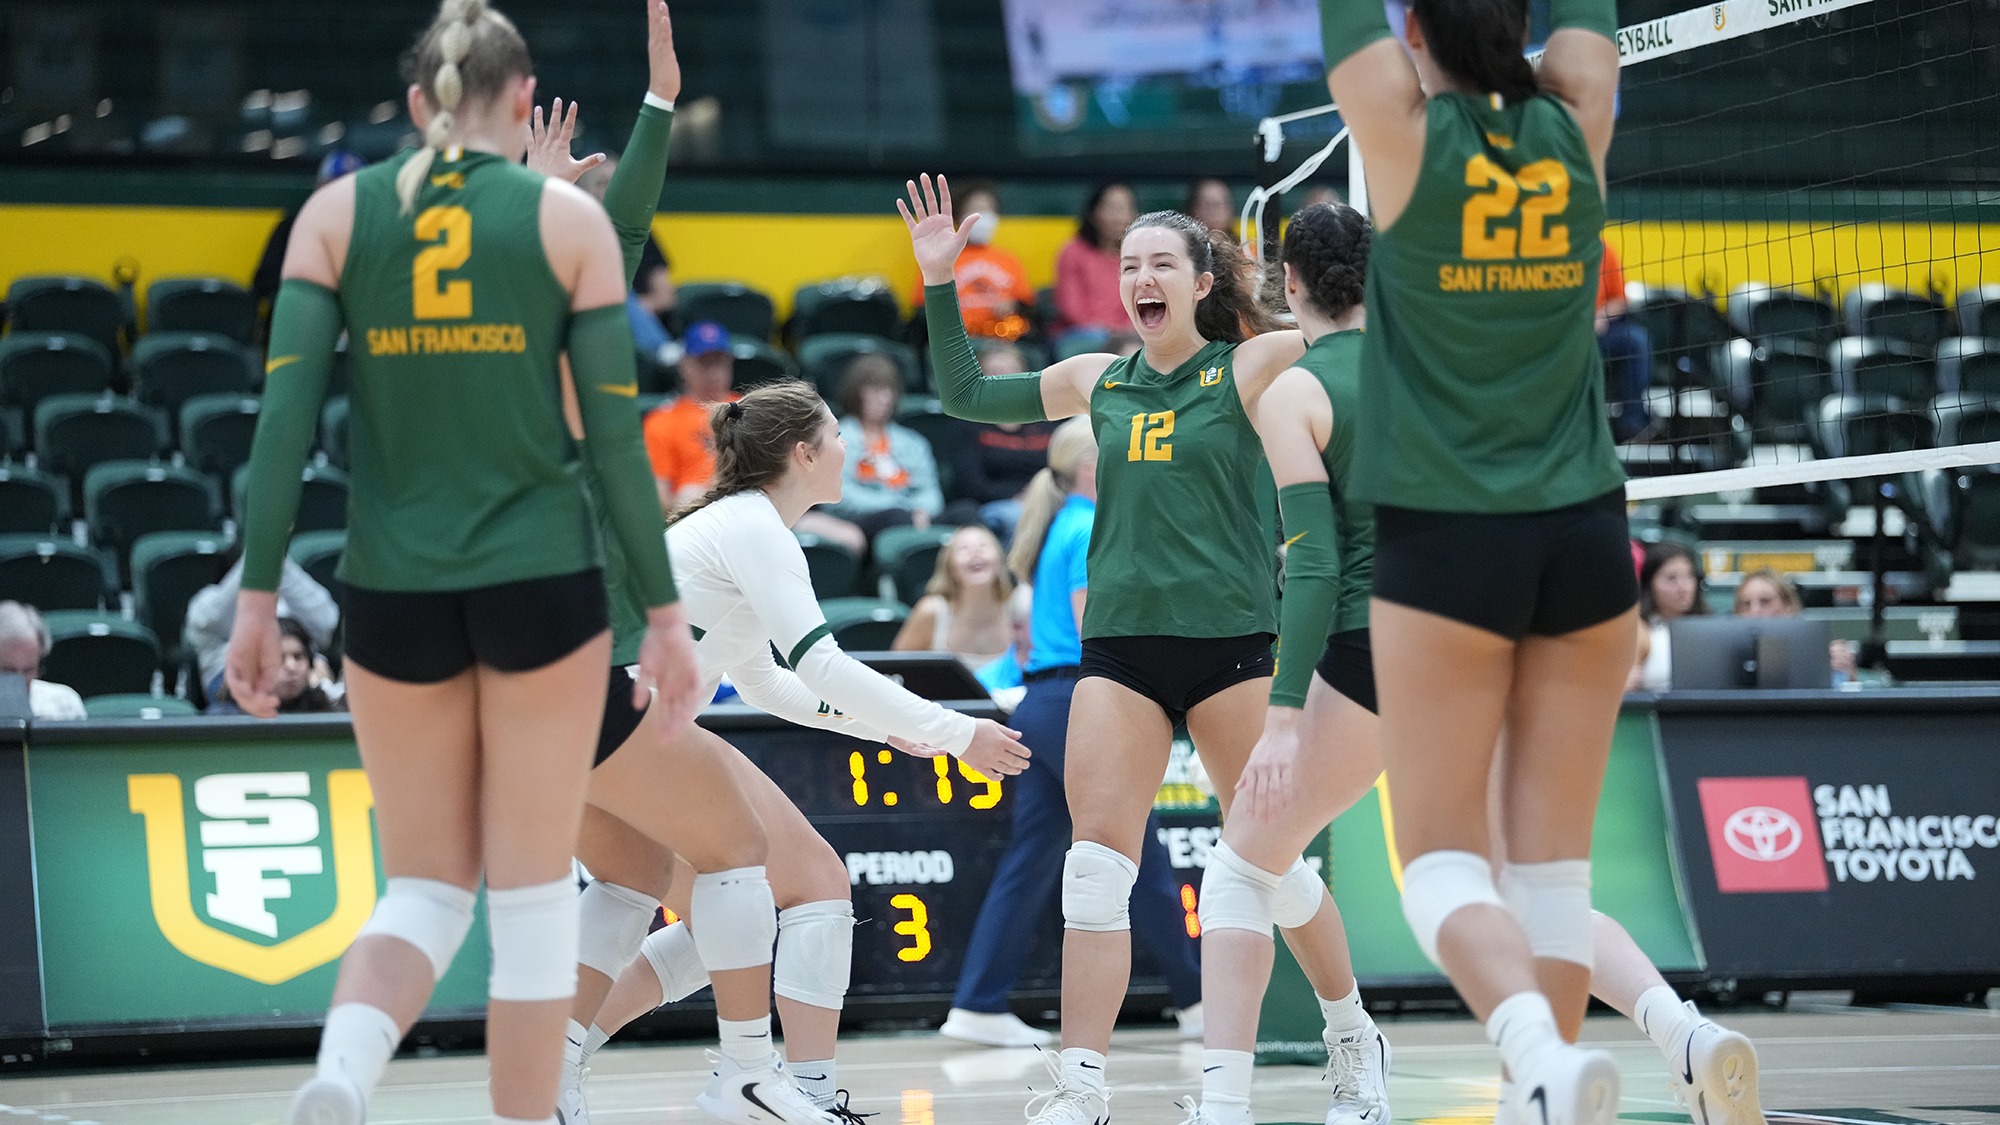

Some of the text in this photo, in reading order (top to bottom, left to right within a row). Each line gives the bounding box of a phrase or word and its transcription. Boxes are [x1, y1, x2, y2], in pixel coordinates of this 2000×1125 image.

[1617, 20, 1673, 57] EYBALL
[1462, 153, 1571, 260] 22
[413, 205, 472, 320] 2
[1439, 262, 1584, 292] SAN FRANCISCO
[366, 324, 526, 356] SAN FRANCISCO
[1127, 410, 1176, 462] 12
[1813, 784, 1892, 817] SAN
[1821, 814, 2000, 849] FRANCISC
[846, 850, 954, 885] PERIOD
[1825, 848, 1977, 882] TOYOTA
[890, 894, 931, 961] 3
[1340, 1036, 1355, 1044] NIKE
